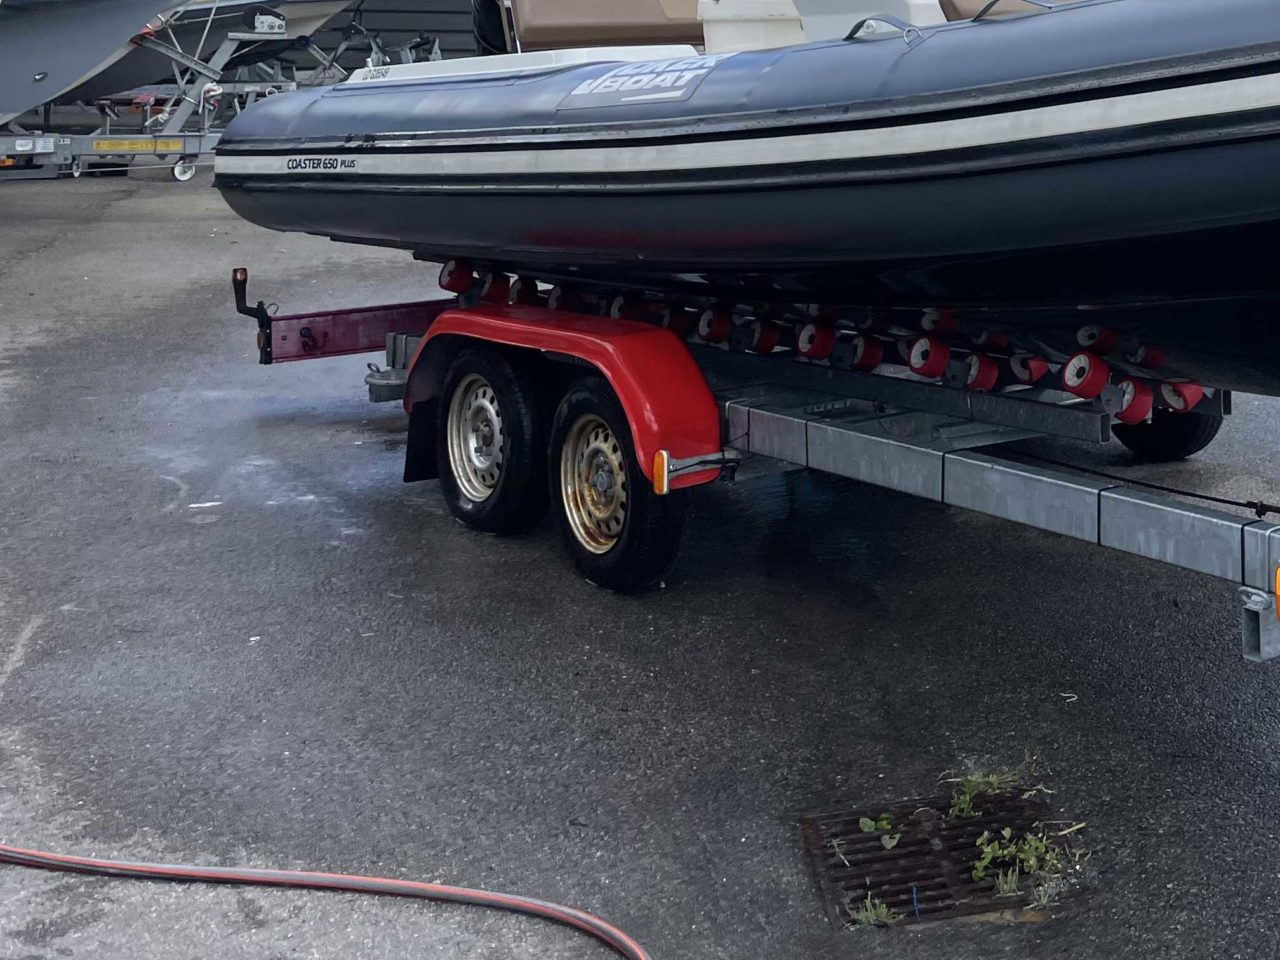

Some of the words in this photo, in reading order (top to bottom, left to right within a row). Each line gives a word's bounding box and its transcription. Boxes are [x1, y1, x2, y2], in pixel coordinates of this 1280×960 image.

[592, 68, 709, 94] BOAT
[287, 158, 322, 170] COASTER
[322, 158, 339, 170] 650
[339, 159, 356, 169] PLUS
